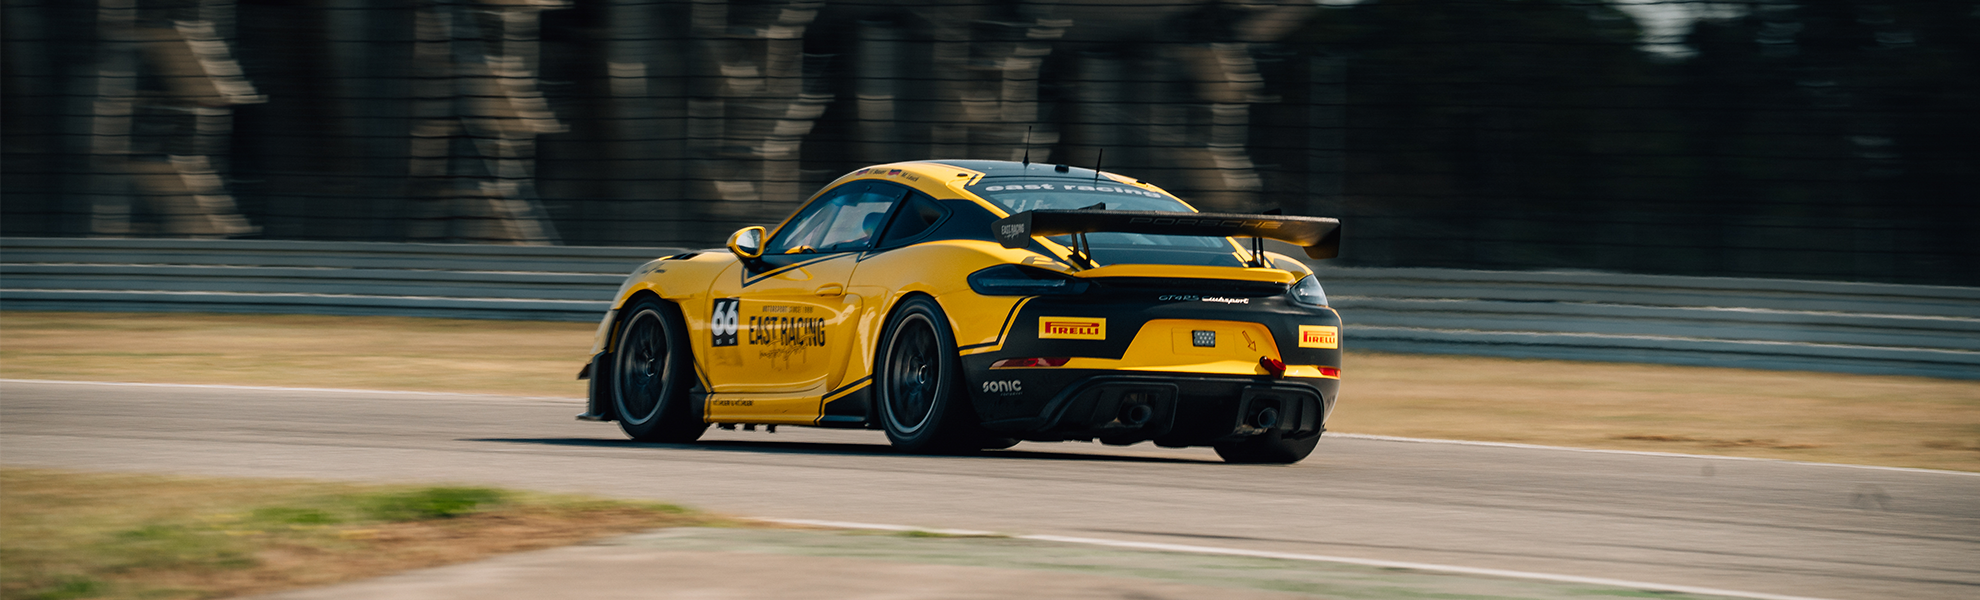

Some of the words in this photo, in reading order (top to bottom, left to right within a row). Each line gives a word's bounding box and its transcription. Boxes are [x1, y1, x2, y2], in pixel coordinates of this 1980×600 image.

[985, 183, 1055, 192] east
[1063, 184, 1161, 199] racing
[1129, 217, 1283, 229] PORSCHE
[711, 301, 739, 336] 66
[749, 316, 778, 346] EAST
[780, 316, 826, 347] RACING
[1045, 322, 1099, 335] PIRELLI
[1303, 331, 1336, 344] PIRELLI
